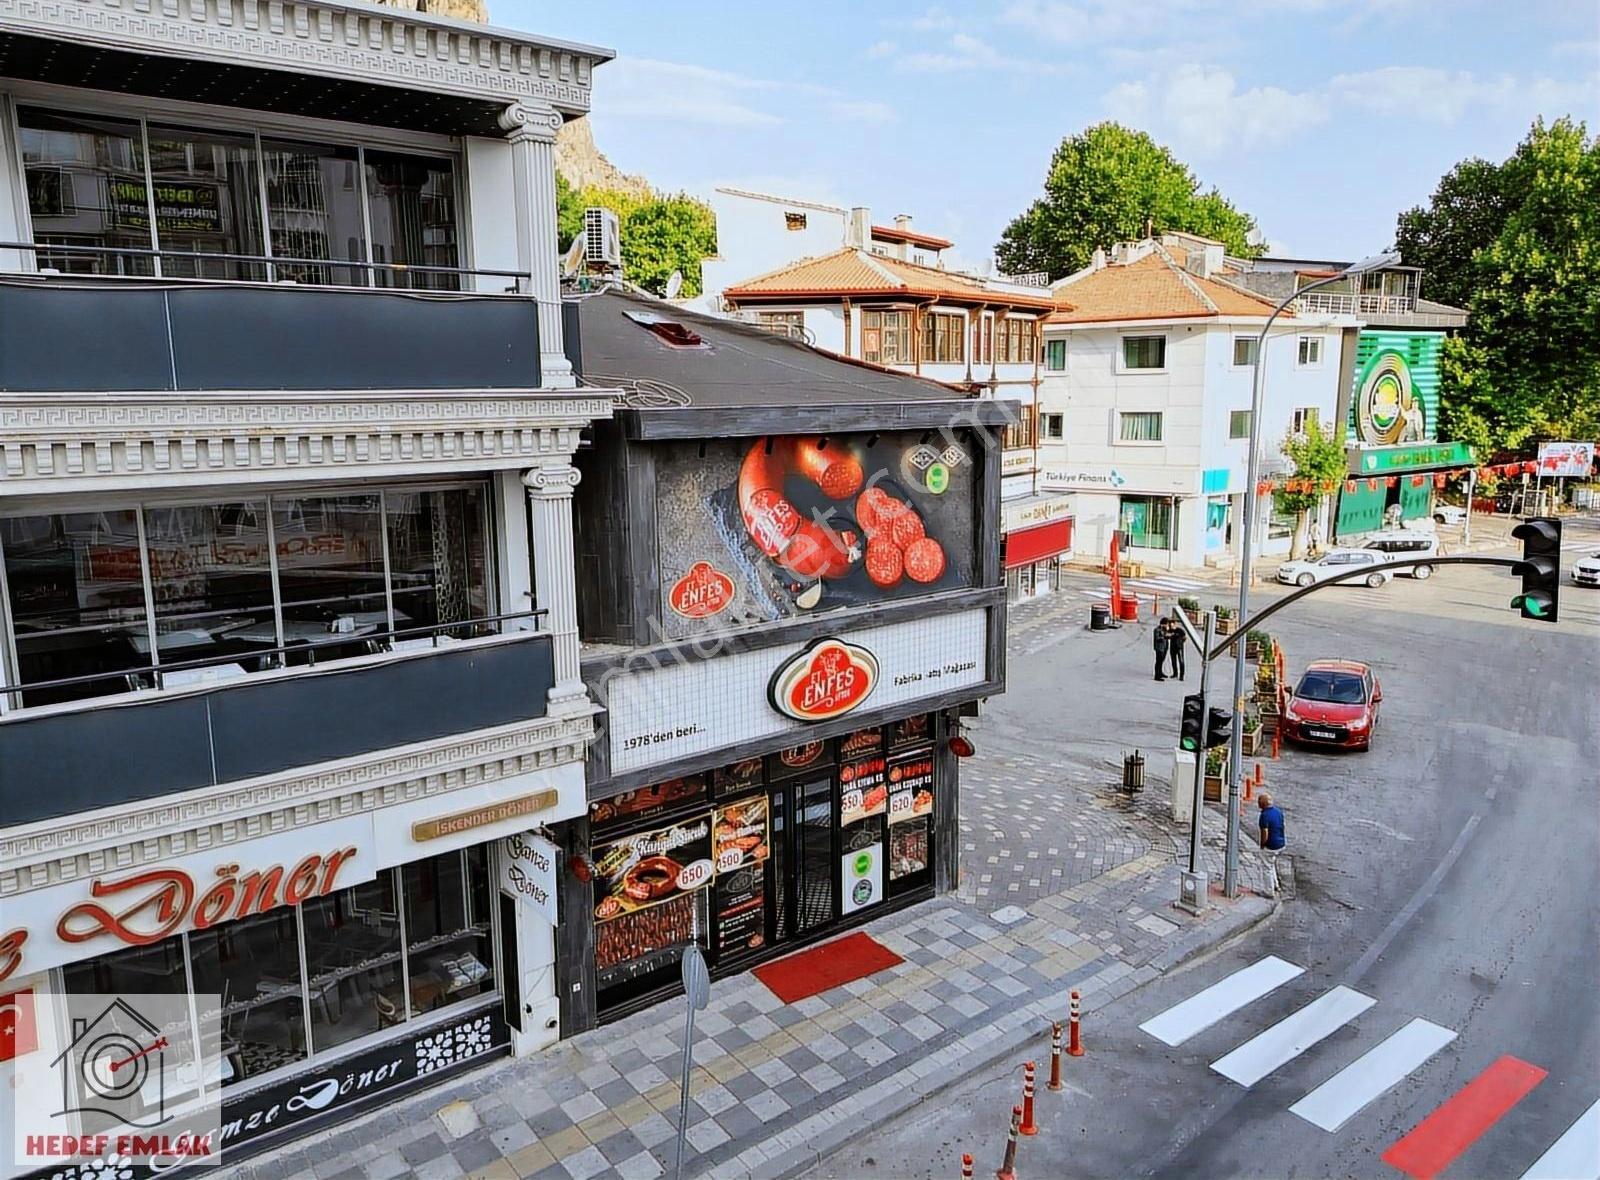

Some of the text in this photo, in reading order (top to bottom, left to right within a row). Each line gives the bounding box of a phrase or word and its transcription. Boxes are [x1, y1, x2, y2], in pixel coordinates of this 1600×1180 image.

[681, 580, 723, 609] ENFES
[804, 667, 855, 706] ENFES
[894, 673, 923, 686] Fabrika
[624, 731, 674, 751] 1978'den
[508, 863, 549, 906] Döner
[682, 865, 703, 885] 650
[56, 846, 358, 945] Döner
[287, 1058, 403, 1111] Döner
